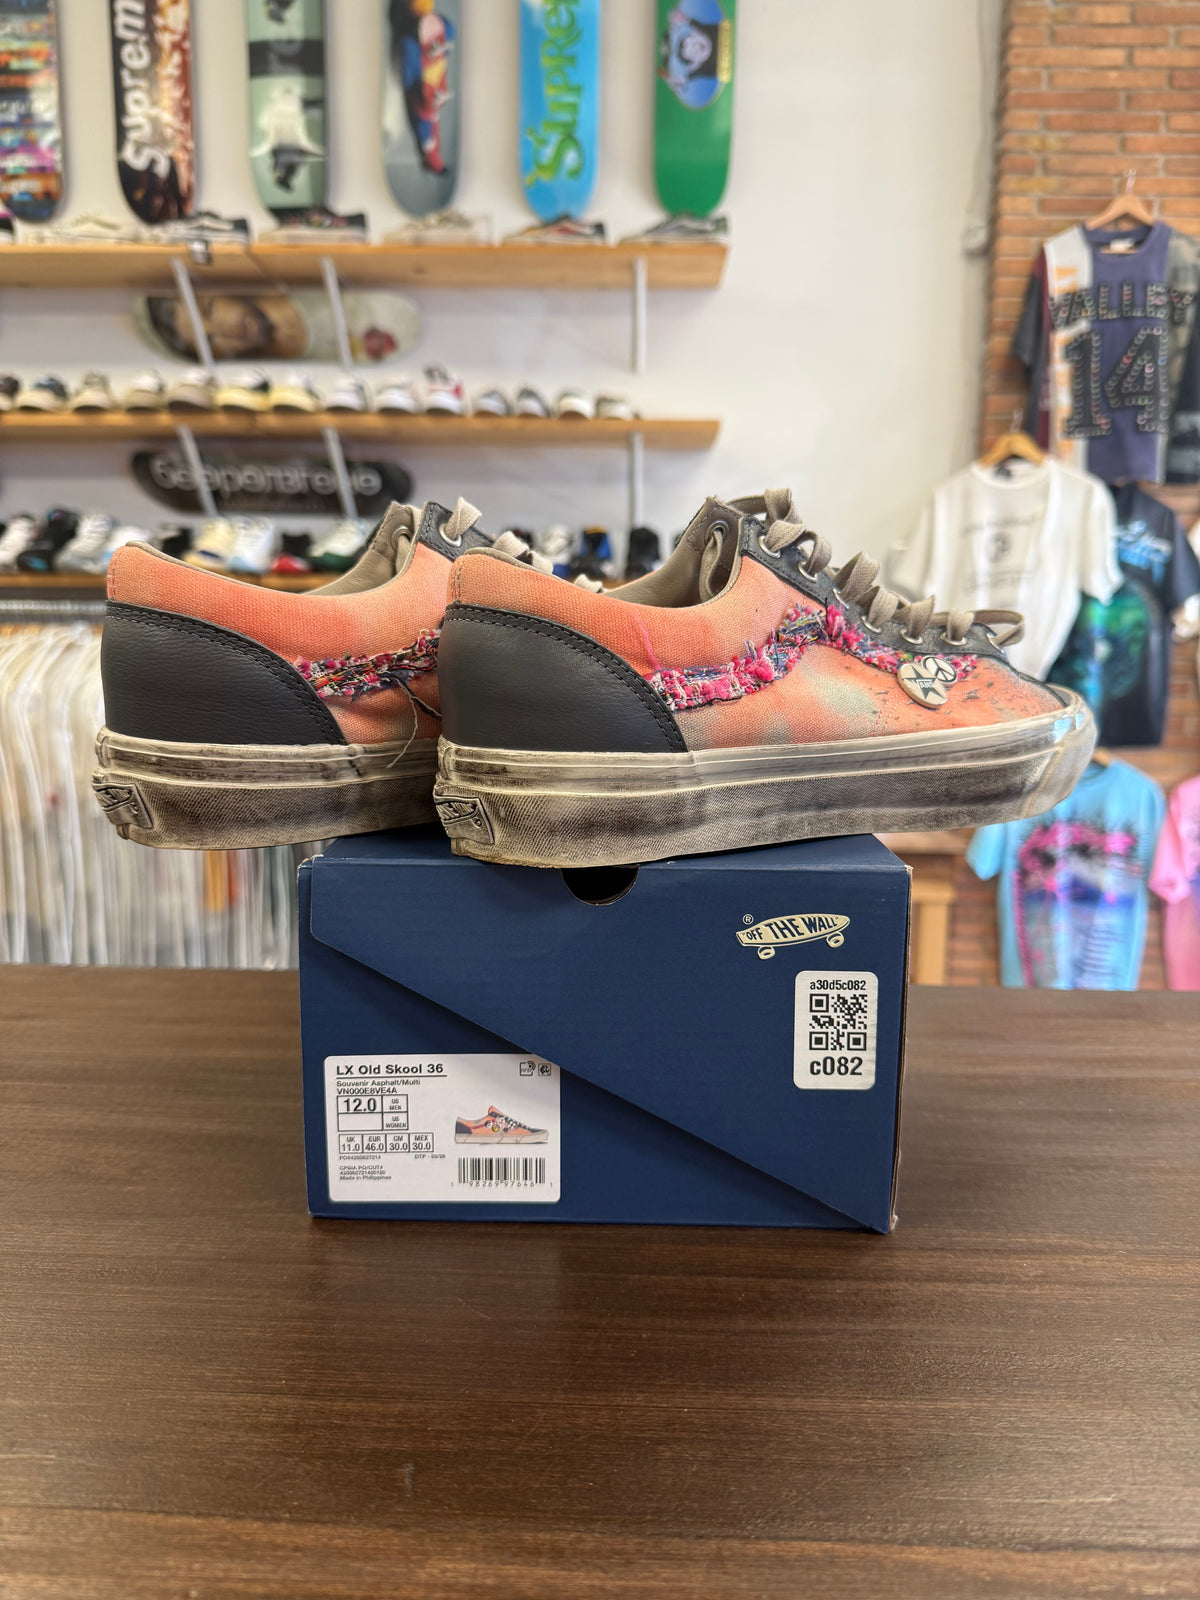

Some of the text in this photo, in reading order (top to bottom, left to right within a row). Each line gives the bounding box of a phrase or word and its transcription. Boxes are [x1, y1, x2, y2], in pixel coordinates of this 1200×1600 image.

[1063, 325, 1169, 438] 14
[764, 918, 805, 940] THE
[809, 979, 867, 991] a30d5c082
[336, 1063, 444, 1076] LX Old Skool 36
[809, 1056, 864, 1076] c082
[371, 1079, 421, 1088] Asphalt/Multi
[343, 1097, 377, 1112] 12.0
[414, 1134, 429, 1142] MEX
[341, 1144, 361, 1152] 11.0
[365, 1143, 384, 1152] 46.0
[389, 1142, 408, 1151] 30.0
[412, 1142, 432, 1151] 30.0
